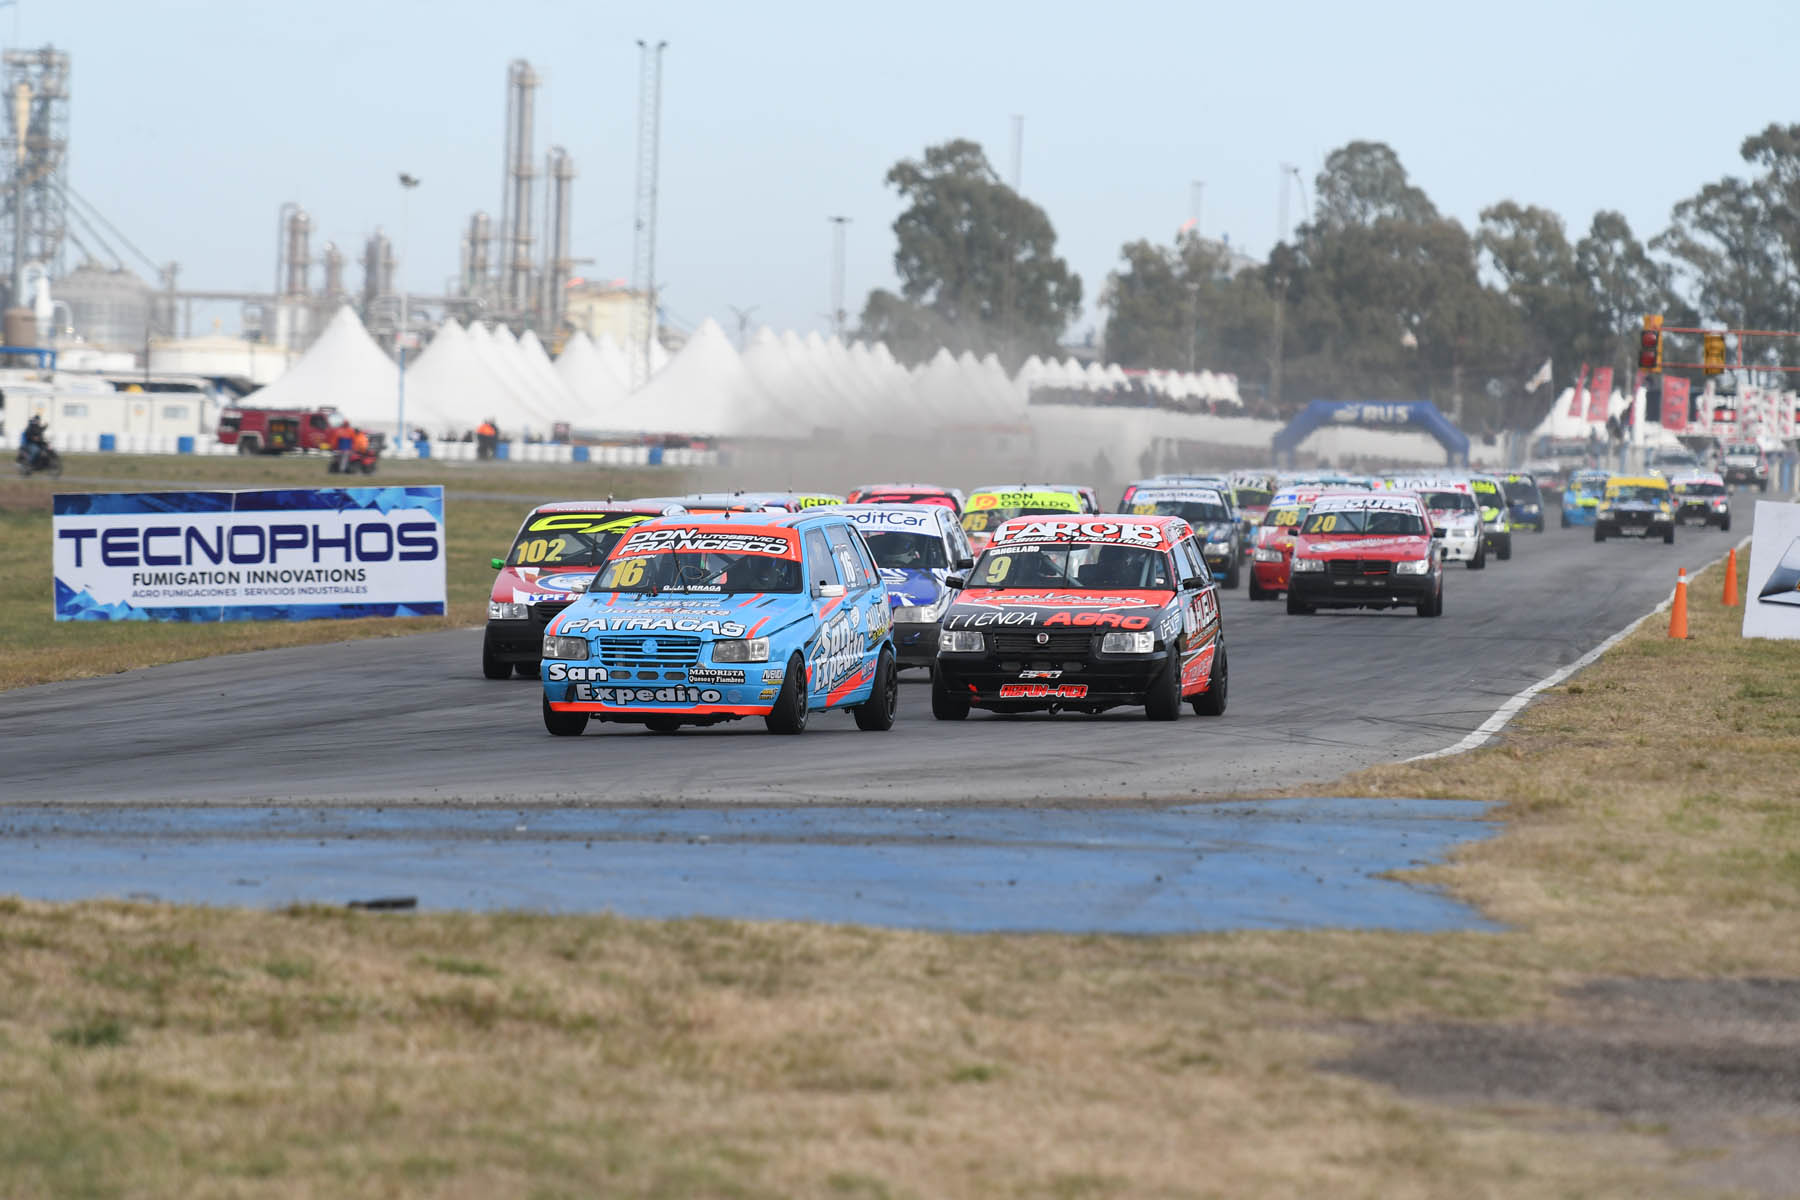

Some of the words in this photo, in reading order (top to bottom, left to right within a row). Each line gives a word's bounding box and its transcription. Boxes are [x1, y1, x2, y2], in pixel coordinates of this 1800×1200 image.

[1001, 492, 1034, 500] DON
[1001, 500, 1071, 508] OSVALDO
[845, 511, 927, 526] editCar
[1274, 511, 1299, 526] 96
[627, 527, 698, 543] DON
[693, 533, 788, 544] AUTOSERVICO
[59, 522, 439, 568] TECNOPHOS
[516, 538, 567, 565] 102
[617, 540, 788, 556] FRANCISCO
[608, 558, 648, 589] 16
[840, 551, 856, 582] 16
[986, 556, 1012, 584] 9
[132, 571, 240, 586] FUMIGATION
[246, 568, 367, 584] INNOVATIONS
[132, 589, 160, 598] AGRO
[162, 587, 237, 598] FUMIGACIONES
[244, 586, 297, 596] SERVICIOS
[298, 585, 368, 596] INDUSTRIALES
[531, 593, 564, 601] YPF
[949, 611, 1038, 629] TIENDA
[1043, 611, 1150, 630] AGRO
[548, 663, 608, 681] San
[688, 669, 745, 677] MAYORISTA
[688, 676, 710, 684] Quesos
[716, 676, 745, 684] Fiambres
[575, 683, 722, 705] Expedito
